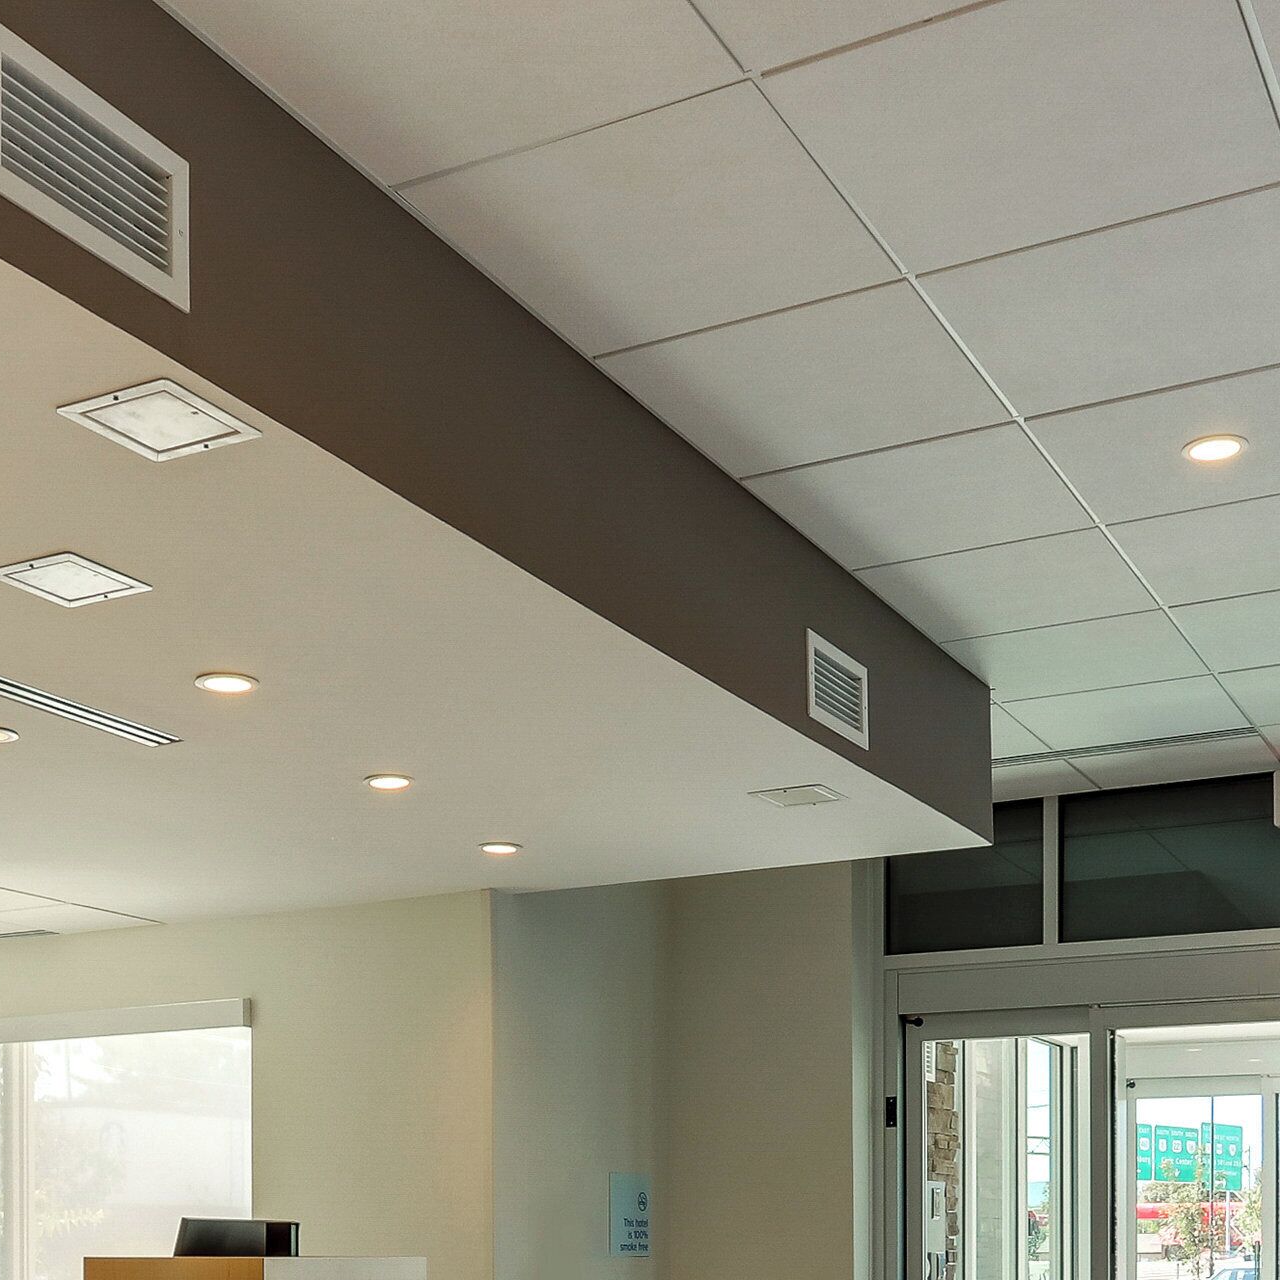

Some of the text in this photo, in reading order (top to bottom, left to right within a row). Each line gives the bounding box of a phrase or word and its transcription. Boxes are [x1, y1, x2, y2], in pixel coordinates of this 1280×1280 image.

[624, 1217, 648, 1227] This hotel
[634, 1230, 648, 1239] 100%
[620, 1242, 649, 1251] smoke free
